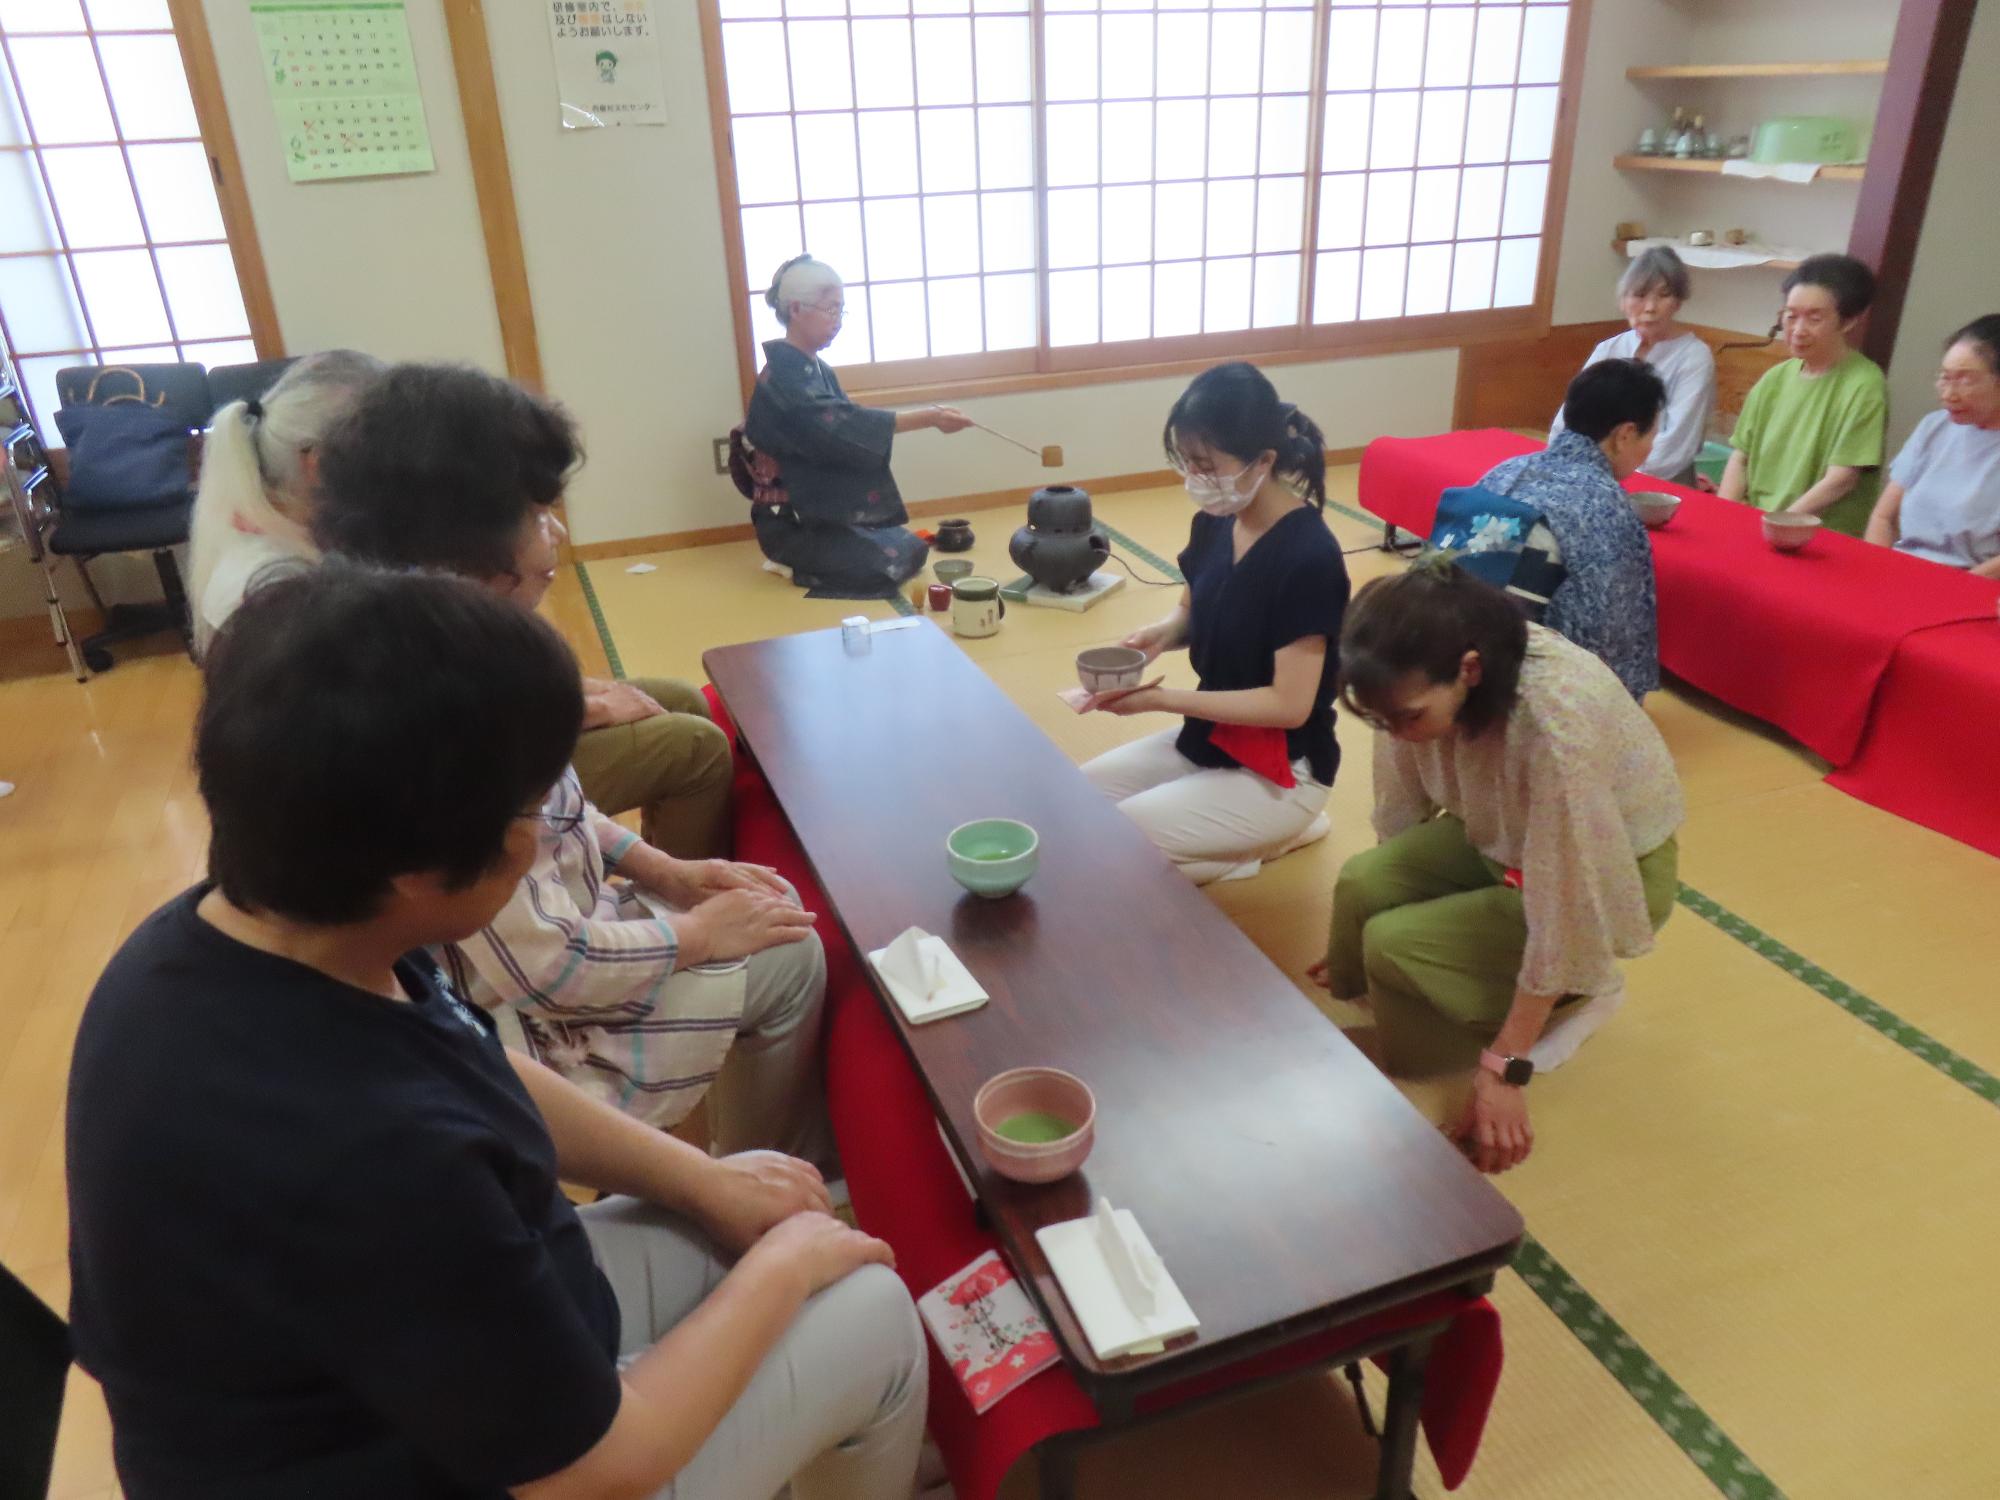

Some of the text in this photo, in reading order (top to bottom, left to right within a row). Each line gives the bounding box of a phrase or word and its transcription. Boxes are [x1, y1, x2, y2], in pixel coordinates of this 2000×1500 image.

[557, 26, 650, 38] ようお願いします。
